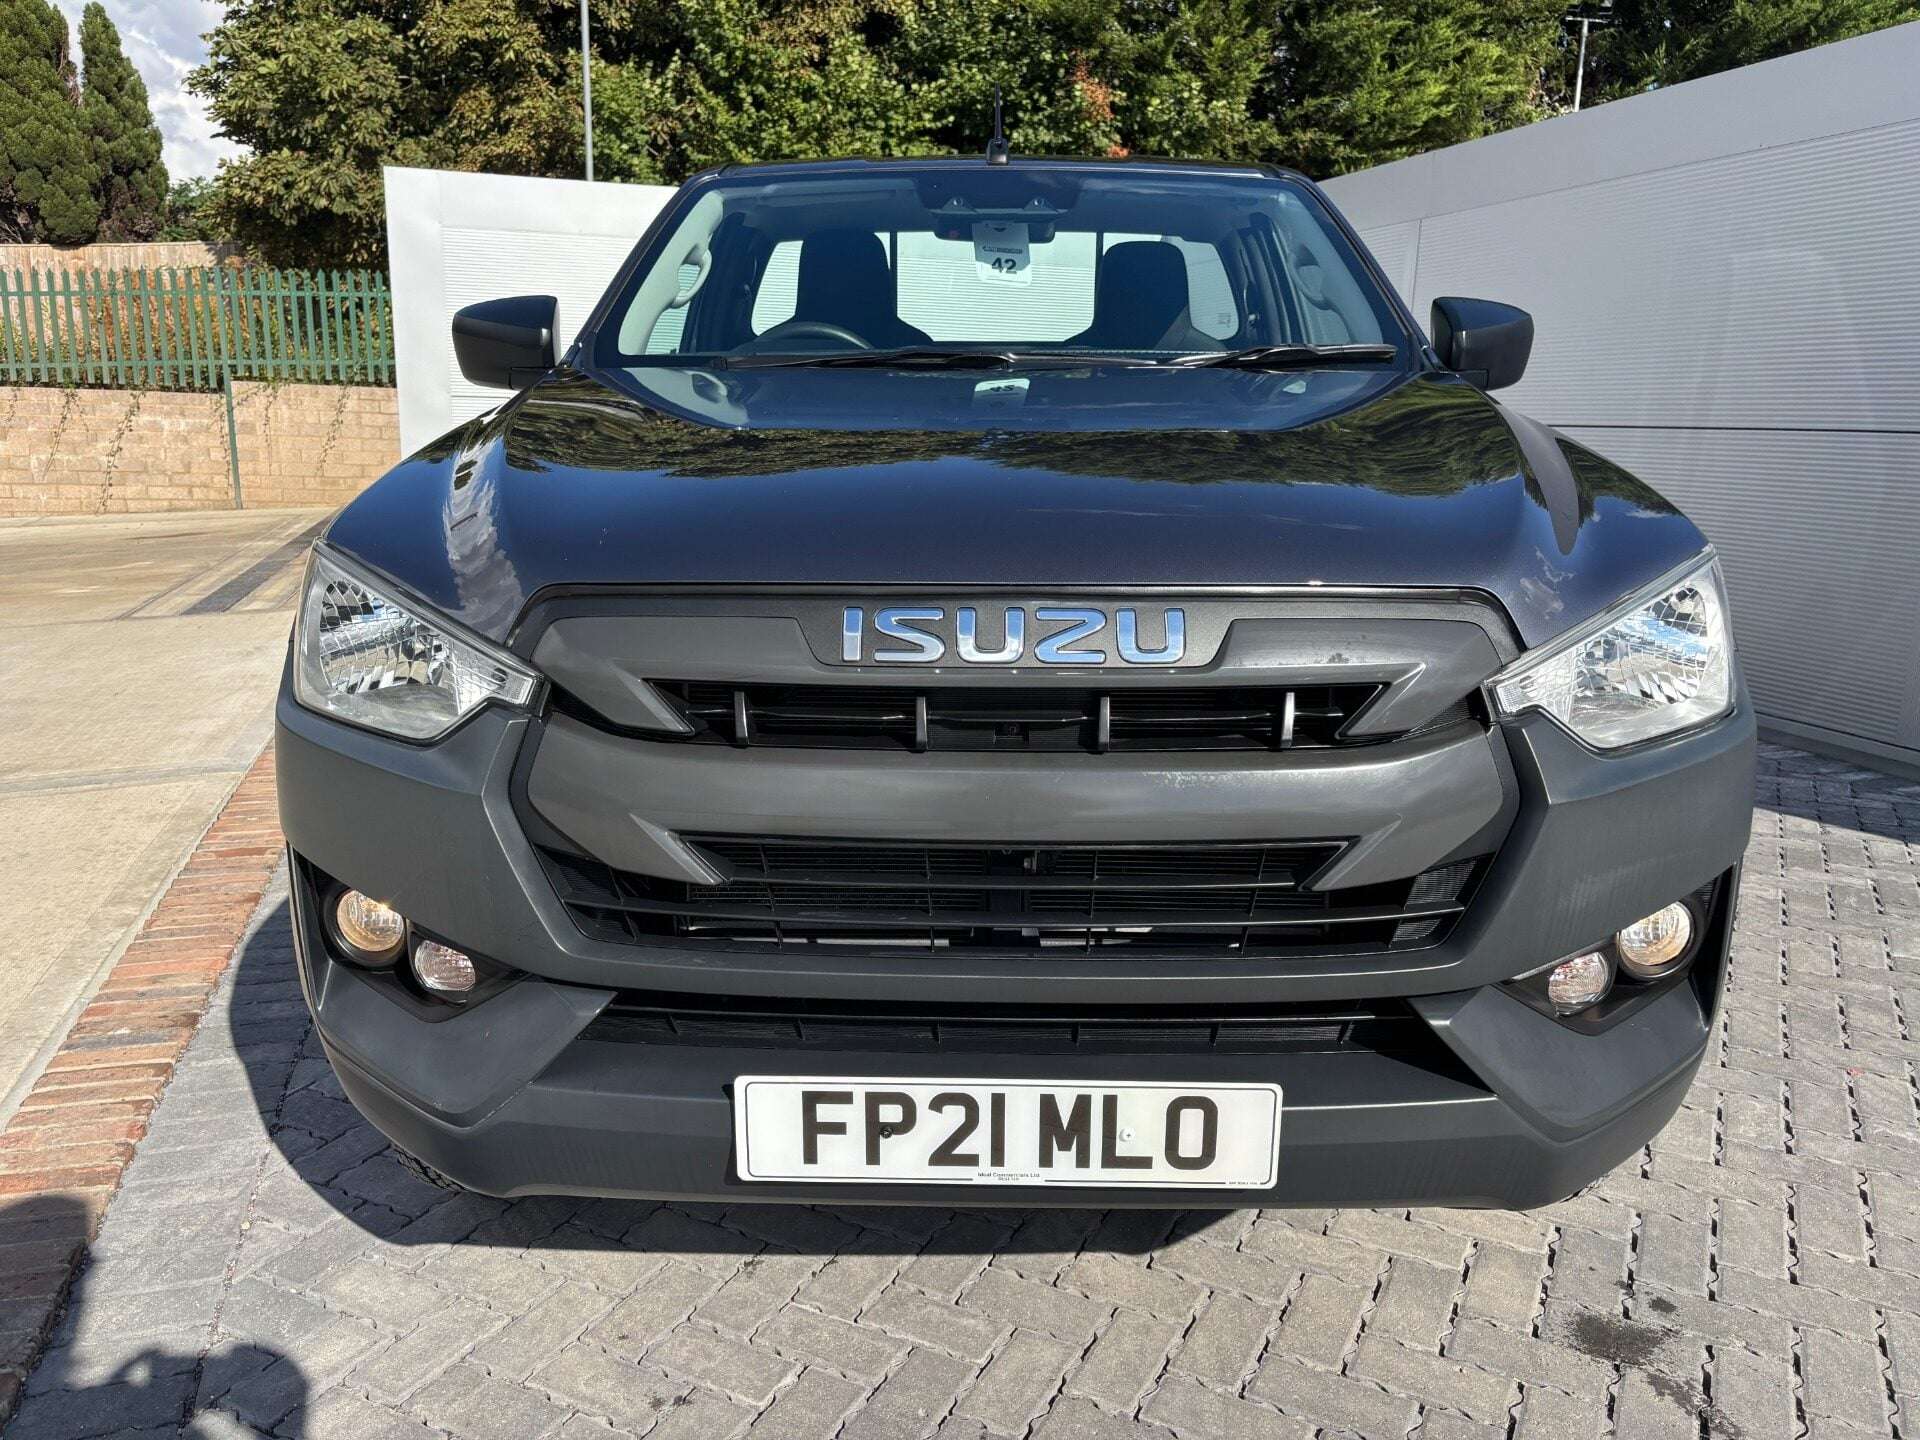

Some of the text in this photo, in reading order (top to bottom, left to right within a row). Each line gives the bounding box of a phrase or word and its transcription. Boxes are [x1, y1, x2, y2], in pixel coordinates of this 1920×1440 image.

[992, 257, 1017, 274] 42
[842, 607, 1187, 664] ISUZU
[801, 1090, 1219, 1170] FP21 MLO
